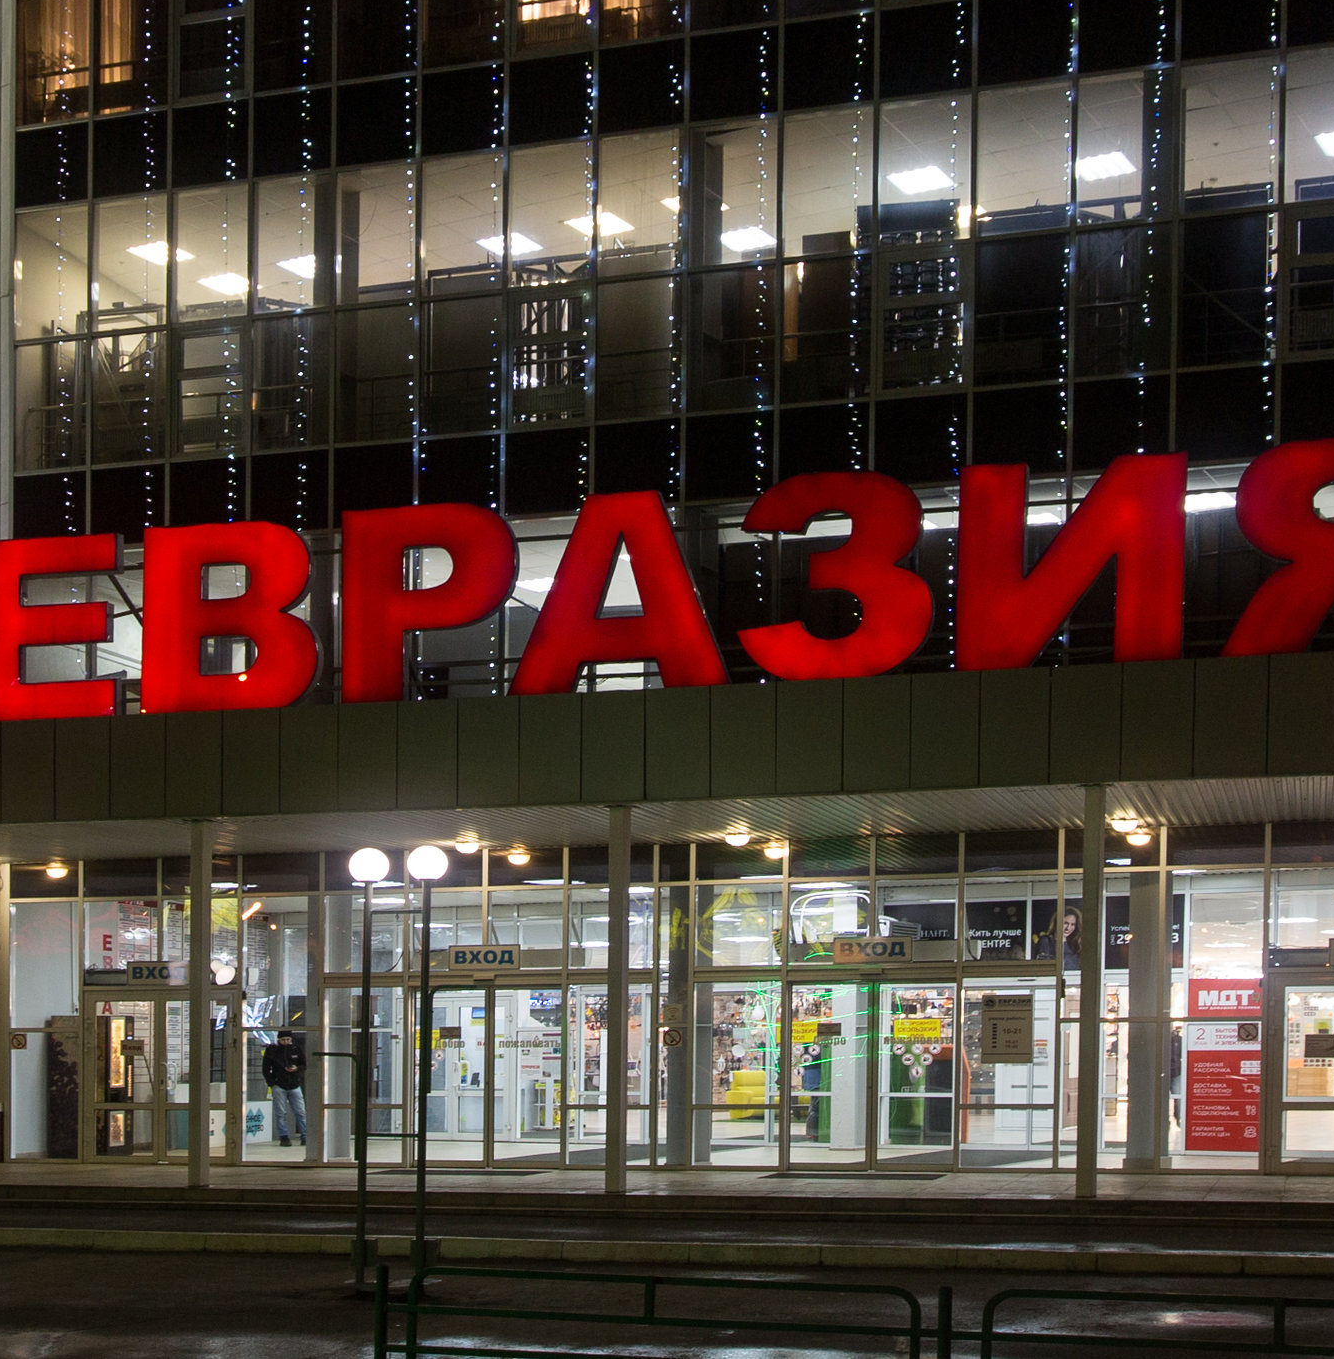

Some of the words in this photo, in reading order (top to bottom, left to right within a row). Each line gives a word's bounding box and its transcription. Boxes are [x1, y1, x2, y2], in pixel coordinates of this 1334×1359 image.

[992, 929, 1022, 939] лучше
[840, 941, 905, 957] ВХОД
[981, 939, 1011, 948] ЕНТРЕ
[455, 950, 514, 965] ВХОД
[1198, 989, 1255, 1007] МДТ
[1196, 1028, 1206, 1041] 2
[499, 1039, 560, 1049] пожаловать
